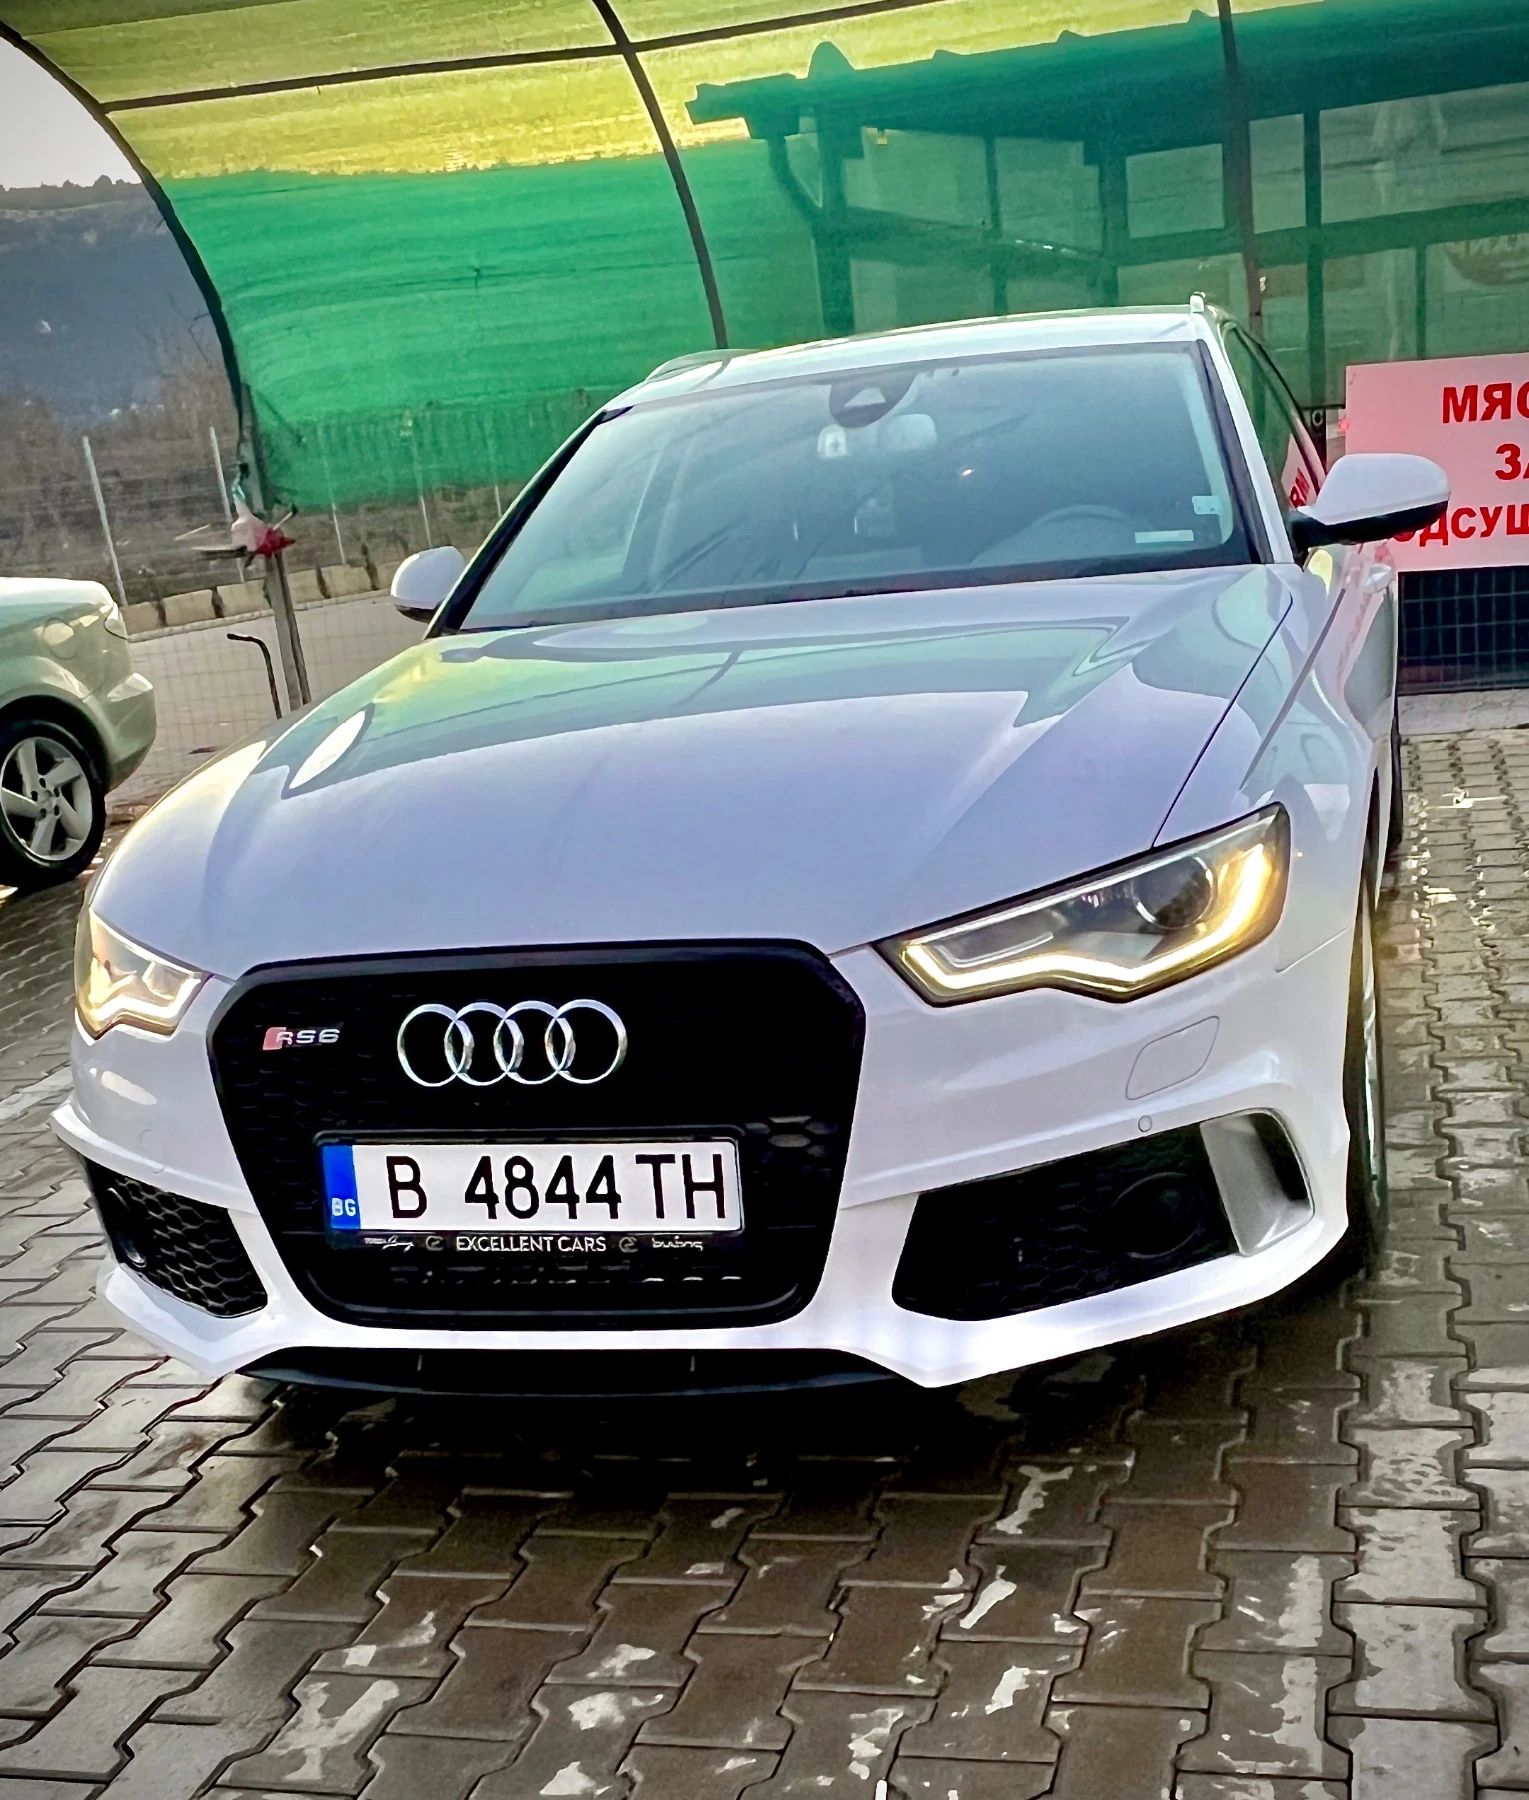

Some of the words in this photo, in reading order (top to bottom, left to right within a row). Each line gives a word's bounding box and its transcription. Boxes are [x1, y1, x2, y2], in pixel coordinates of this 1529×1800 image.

[1495, 443, 1529, 481] З
[270, 1028, 341, 1047] RS6
[385, 1155, 428, 1219] B
[464, 1155, 623, 1220] 4844
[635, 1153, 726, 1219] TH
[330, 1197, 357, 1217] BG
[455, 1235, 554, 1252] EXCELLENT
[557, 1235, 607, 1253] CARS
